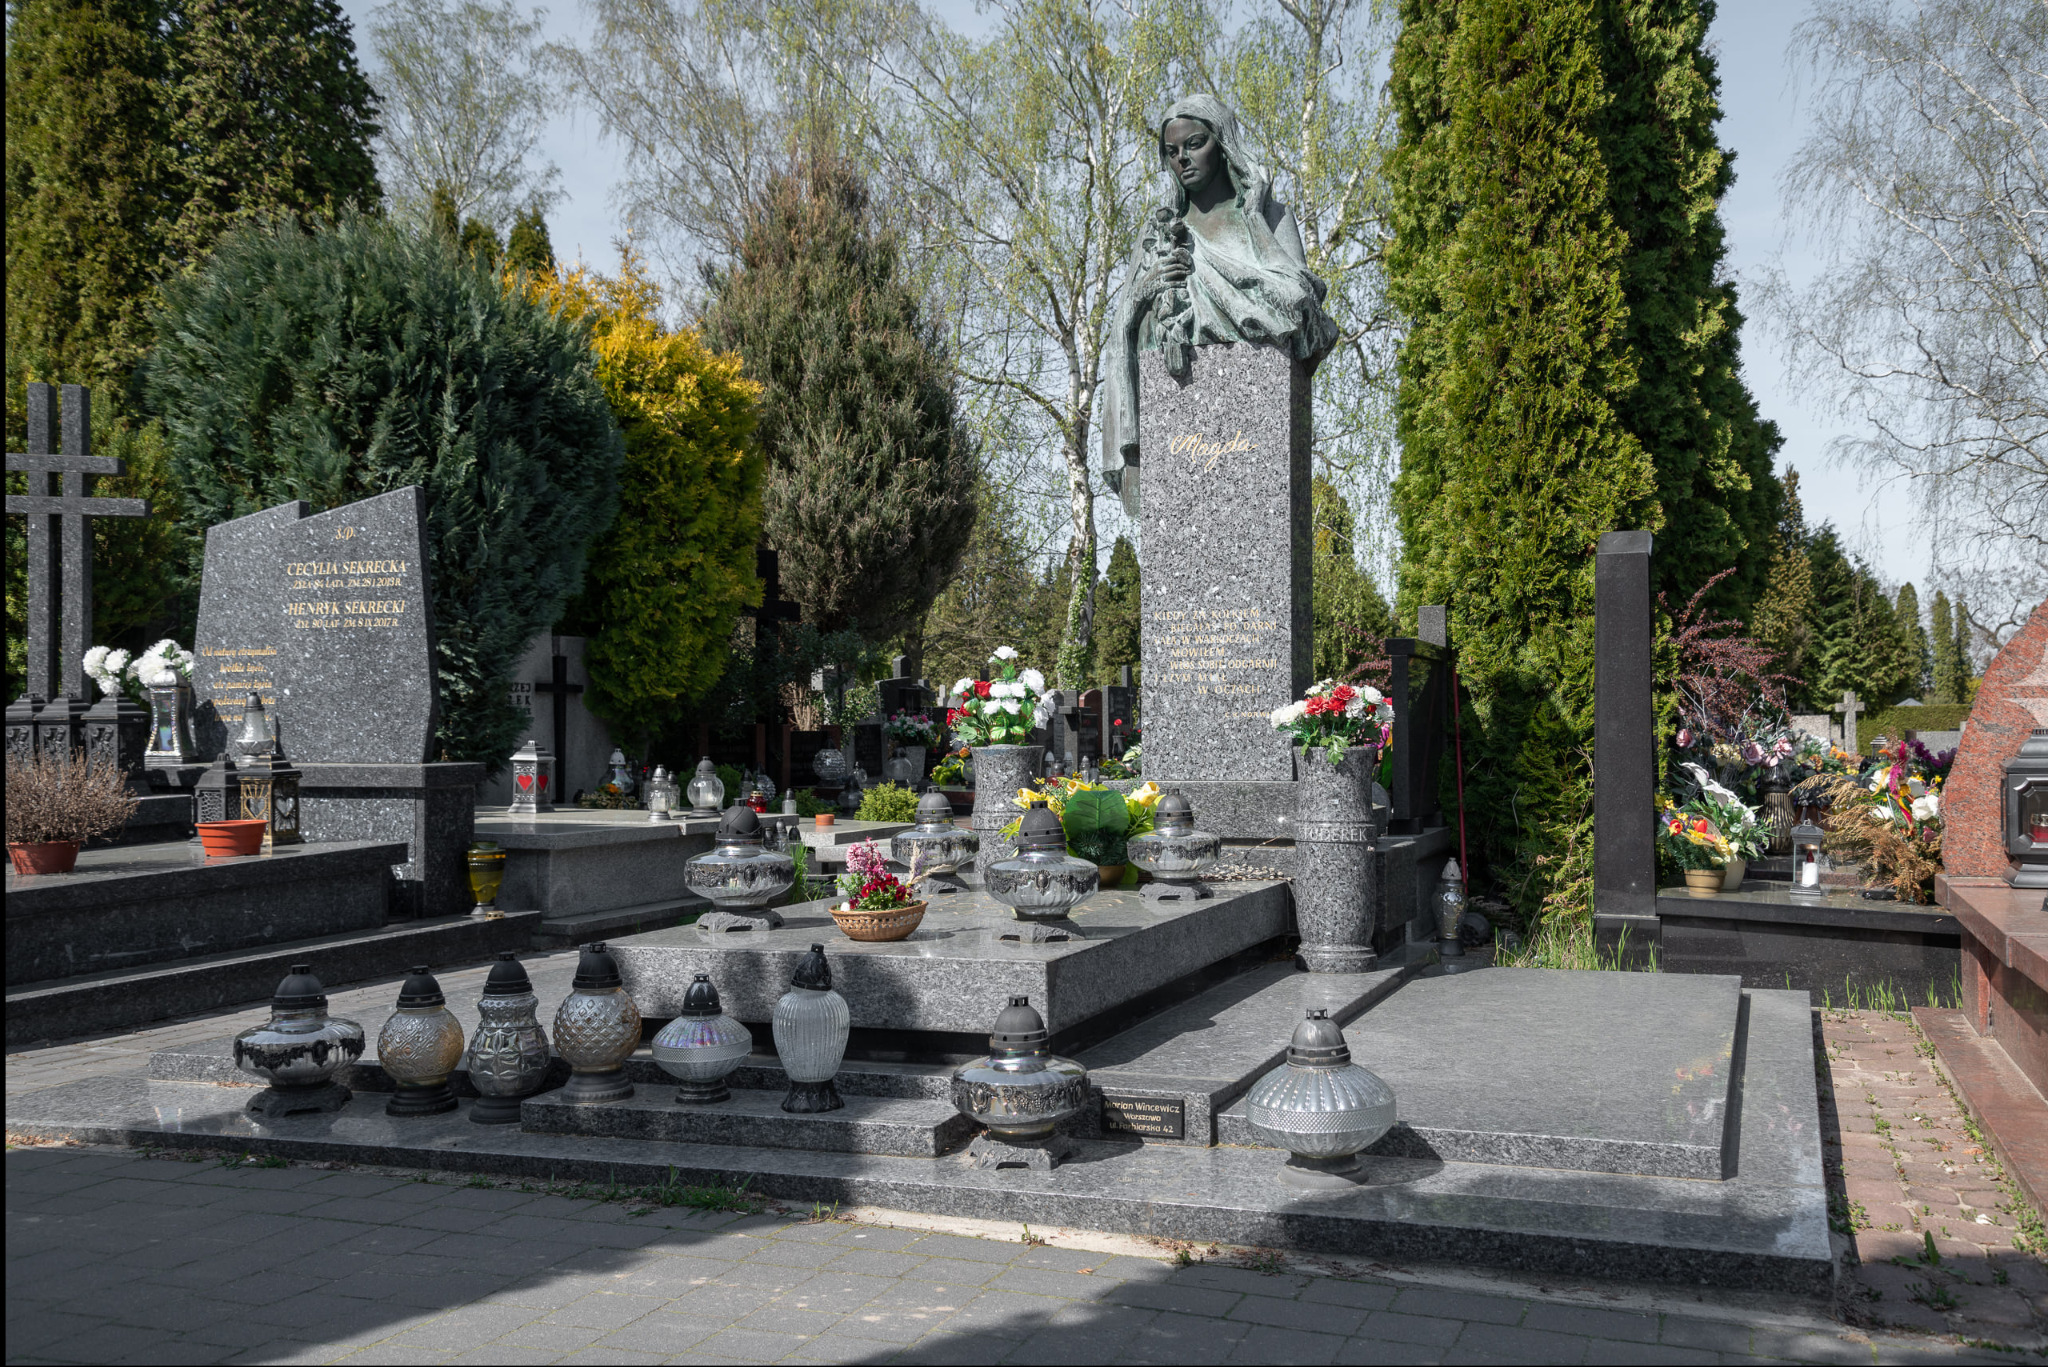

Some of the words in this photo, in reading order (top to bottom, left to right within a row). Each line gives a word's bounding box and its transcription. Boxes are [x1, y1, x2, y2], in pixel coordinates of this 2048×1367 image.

[1171, 430, 1259, 473] Magda
[287, 561, 338, 576] CECYLIA
[341, 560, 407, 575] SEKRECKA
[325, 579, 344, 588] LATA
[288, 602, 340, 615] HENRYK
[344, 600, 406, 614] SEKRECKI
[325, 619, 340, 628] LAT
[373, 617, 392, 627] 2017
[1224, 622, 1237, 631] PO
[1244, 619, 1277, 631] DARNI
[1104, 1100, 1134, 1110] Marian
[1134, 1101, 1181, 1114] Wincewicz
[1123, 1112, 1162, 1122] Warszawa
[1162, 1125, 1174, 1133] 42
